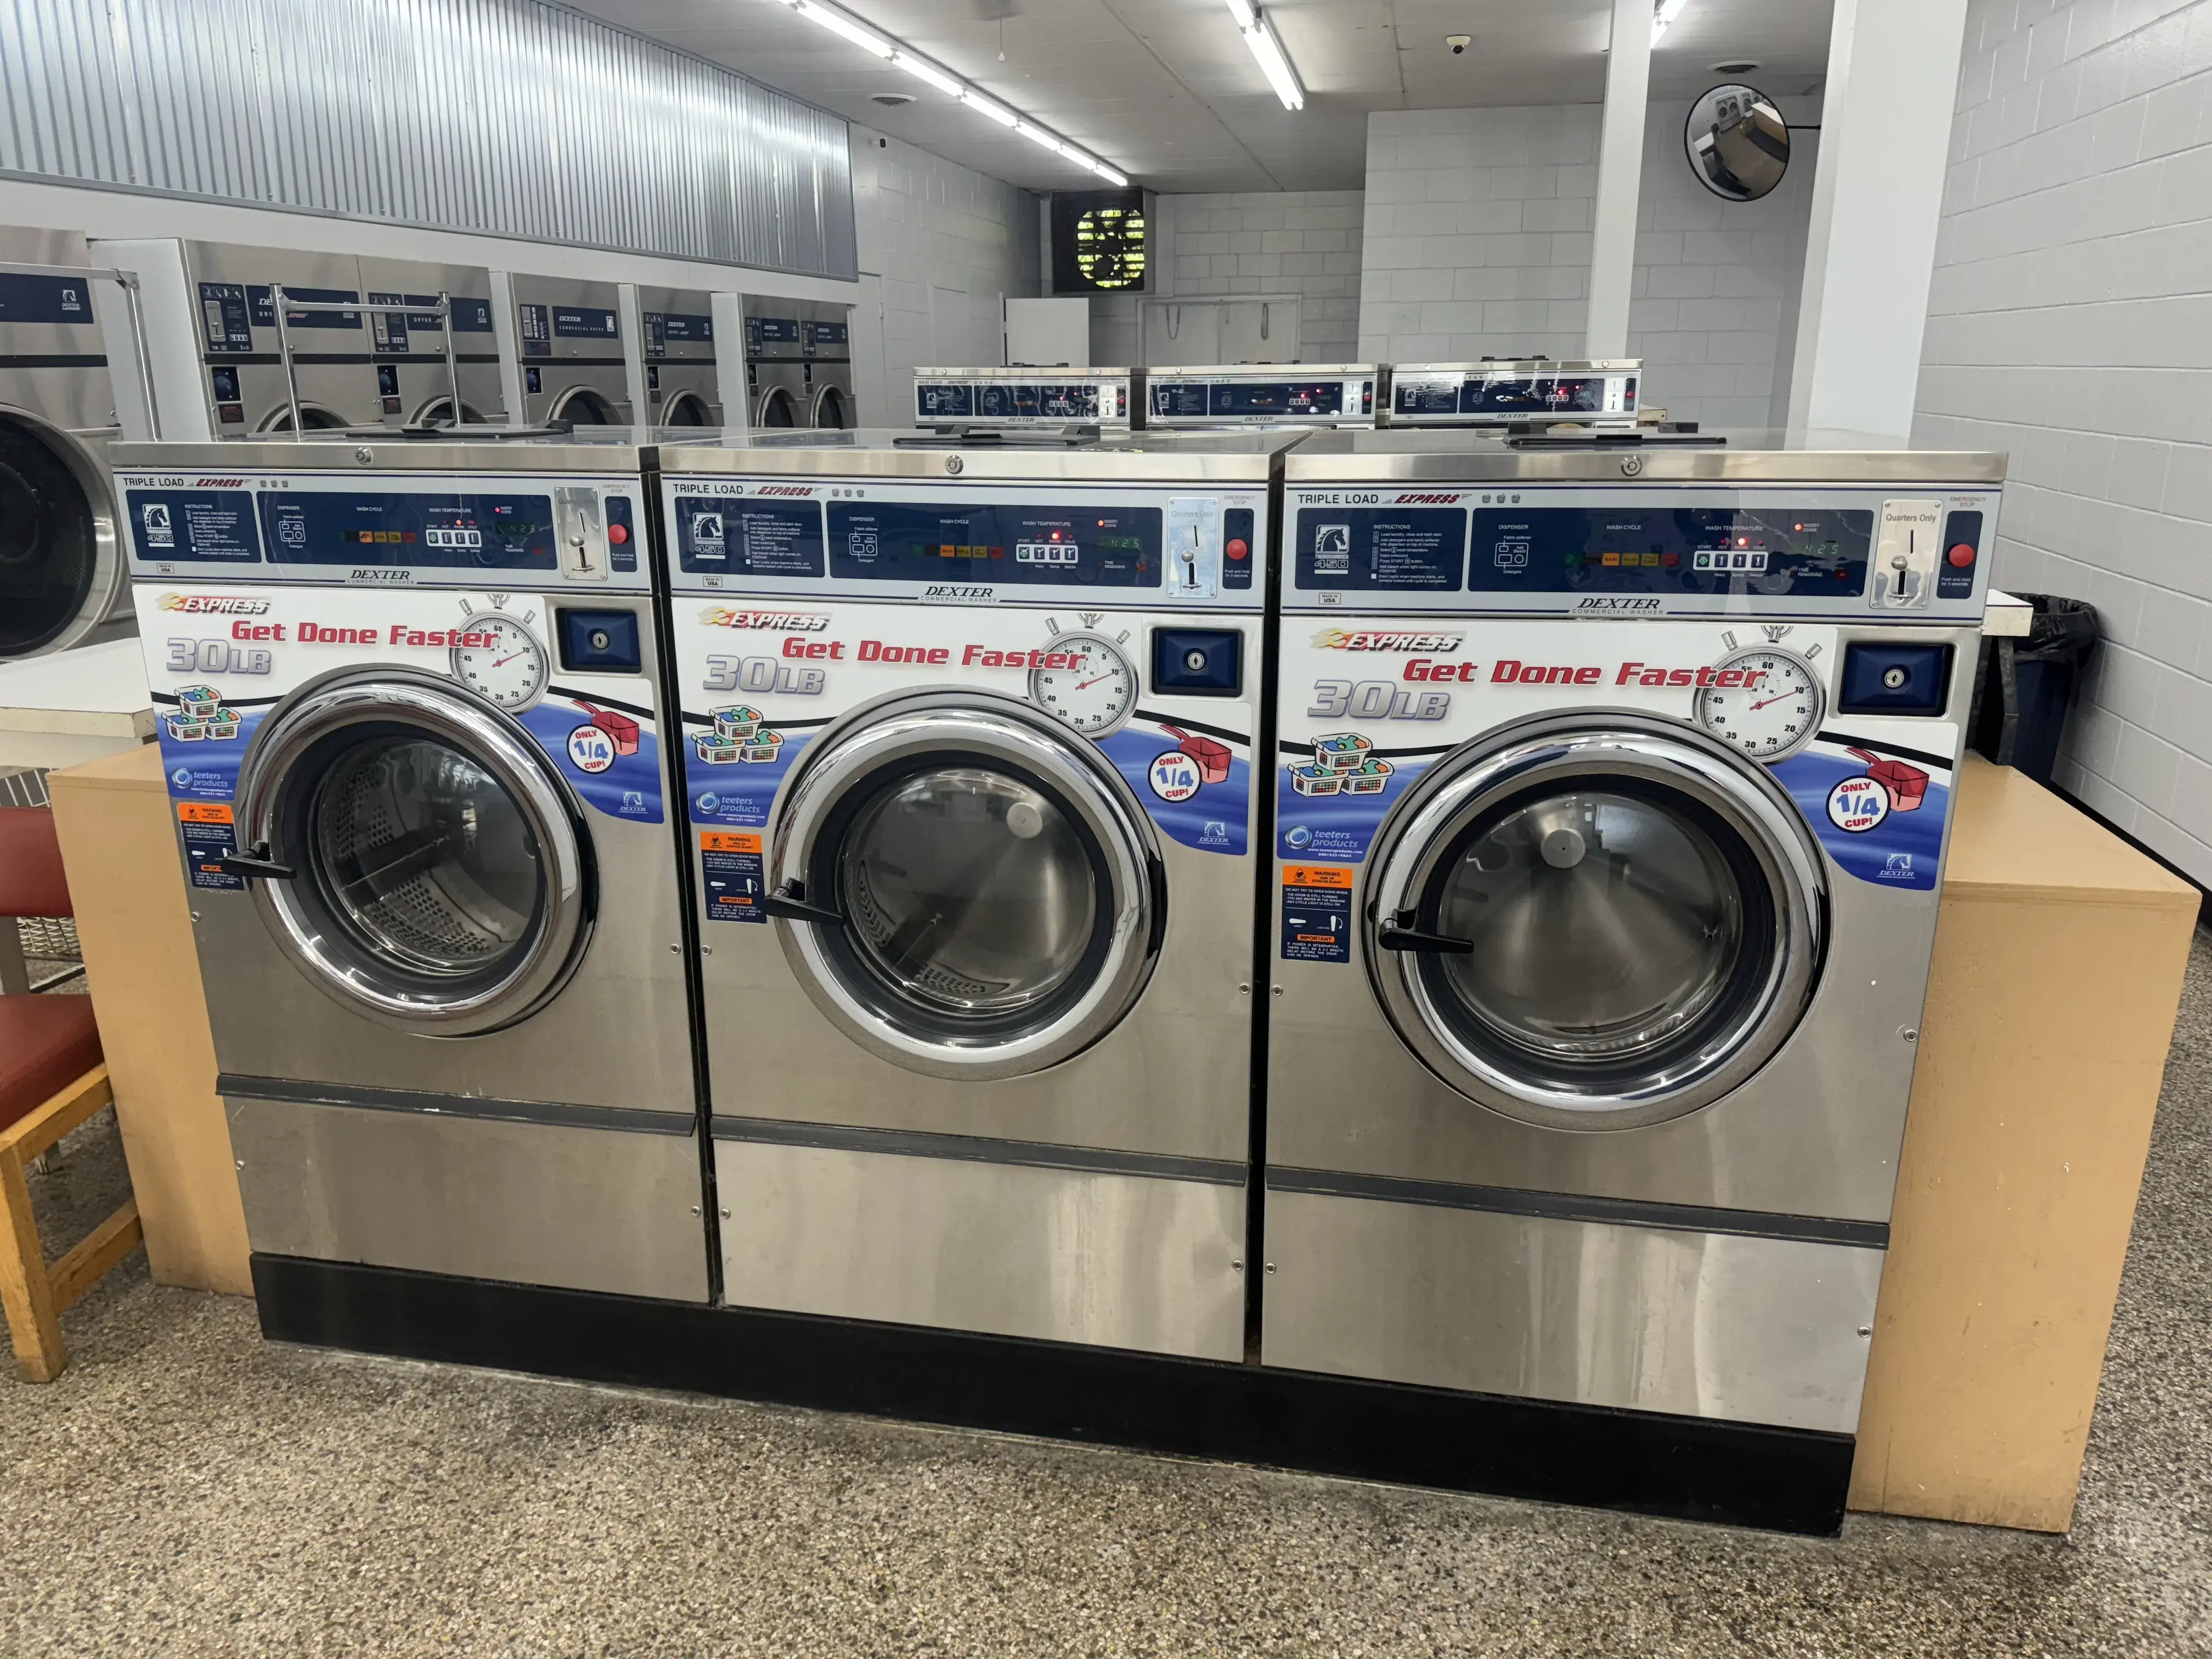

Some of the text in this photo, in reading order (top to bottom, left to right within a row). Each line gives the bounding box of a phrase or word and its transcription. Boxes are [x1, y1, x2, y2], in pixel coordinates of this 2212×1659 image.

[123, 478, 244, 487] TRIPLE LOAD EXPRESS
[673, 484, 813, 496] TRIPLE LOAD EXPRESS
[1298, 494, 1460, 504] TRIPLE LOAD EXPRESS
[1886, 514, 1937, 523] Quarters Only
[147, 534, 173, 542] 450
[695, 545, 725, 554] 450
[1314, 560, 1348, 568] 450
[351, 569, 410, 580] DEXTER
[925, 586, 993, 597] DEXTER
[183, 597, 271, 615] EXPRESS
[1577, 598, 1660, 608] DEXTER
[729, 612, 828, 631] EXPRESS
[232, 620, 499, 648] Get Done Faster
[1346, 633, 1466, 652] EXPRESS
[166, 637, 272, 674] 30LB
[782, 637, 1086, 670] Get Done Faster
[703, 654, 825, 695] 30LB
[1403, 659, 1767, 688] Get Done Faster
[1307, 679, 1451, 720] 30LB
[1714, 716, 1725, 724] 40
[1785, 725, 1796, 733] 20
[575, 730, 597, 739] ONLY
[574, 740, 609, 759] 1/4
[584, 760, 606, 769] CUP!
[1159, 756, 1184, 766] ONLY
[1156, 767, 1194, 788] 1/4
[193, 779, 228, 787] products
[1841, 782, 1872, 793] ONLY
[1165, 789, 1189, 798] CUP!
[720, 804, 760, 813] products
[1837, 794, 1881, 816] 1/4
[1844, 817, 1873, 828] CUP!
[1315, 830, 1351, 839] teeters
[1311, 839, 1358, 848] products
